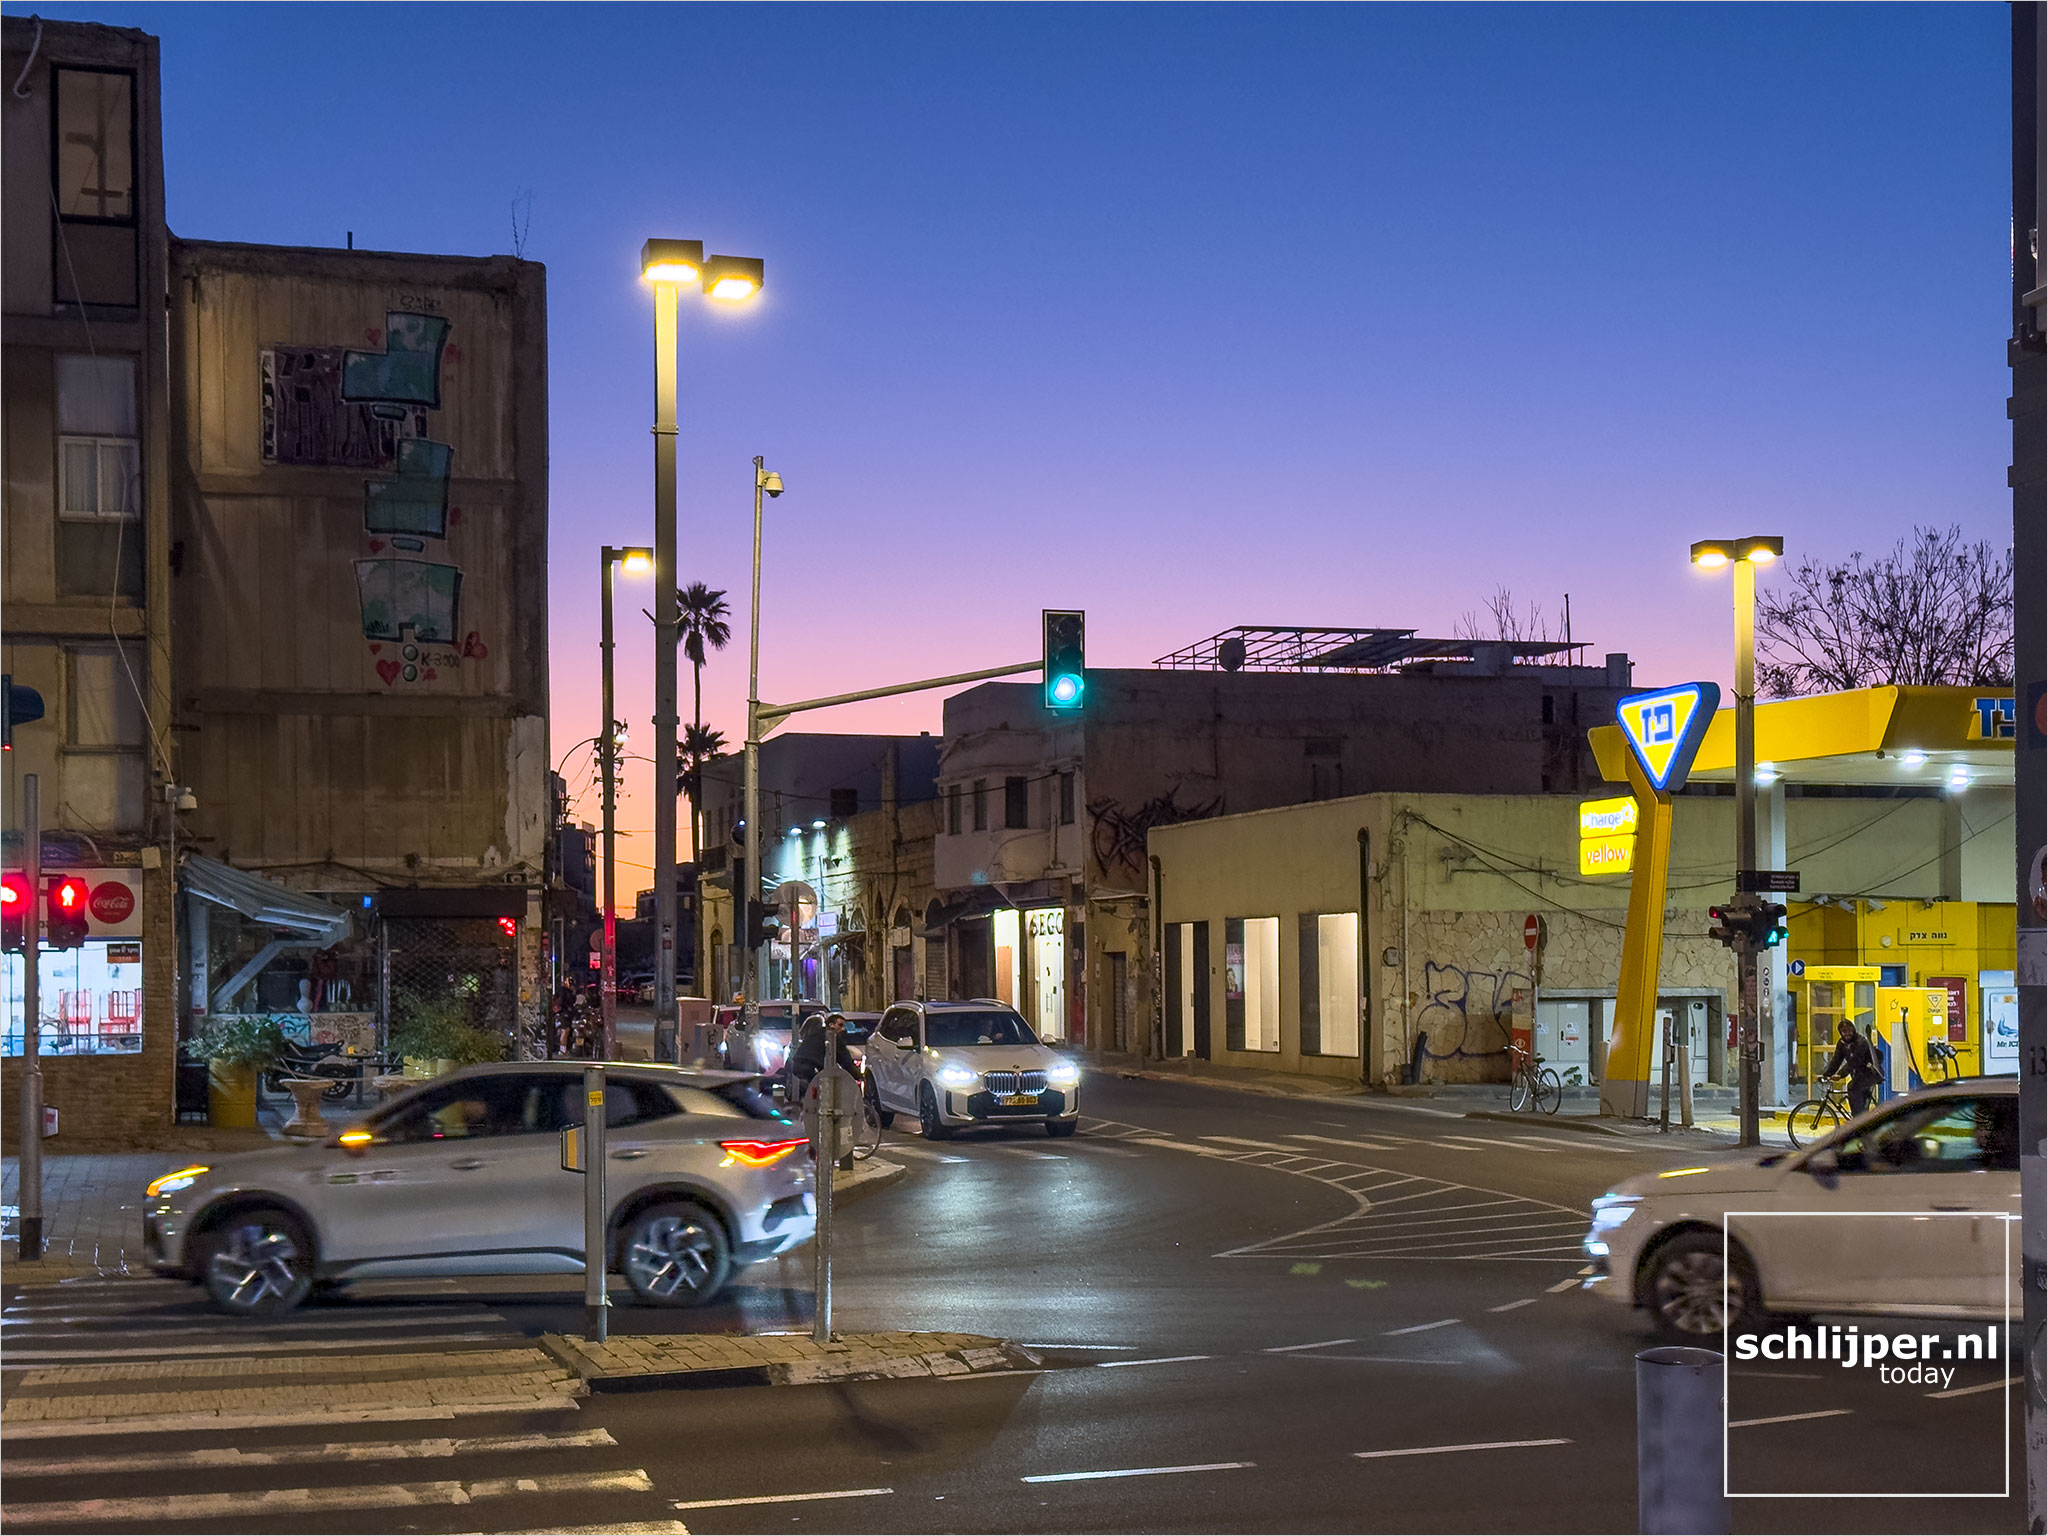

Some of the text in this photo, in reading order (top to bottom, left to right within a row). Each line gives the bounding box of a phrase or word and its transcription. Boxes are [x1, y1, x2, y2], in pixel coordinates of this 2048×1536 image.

[1640, 701, 1675, 746] פז
[1585, 843, 1628, 867] yellow
[1909, 932, 1927, 940] צדק
